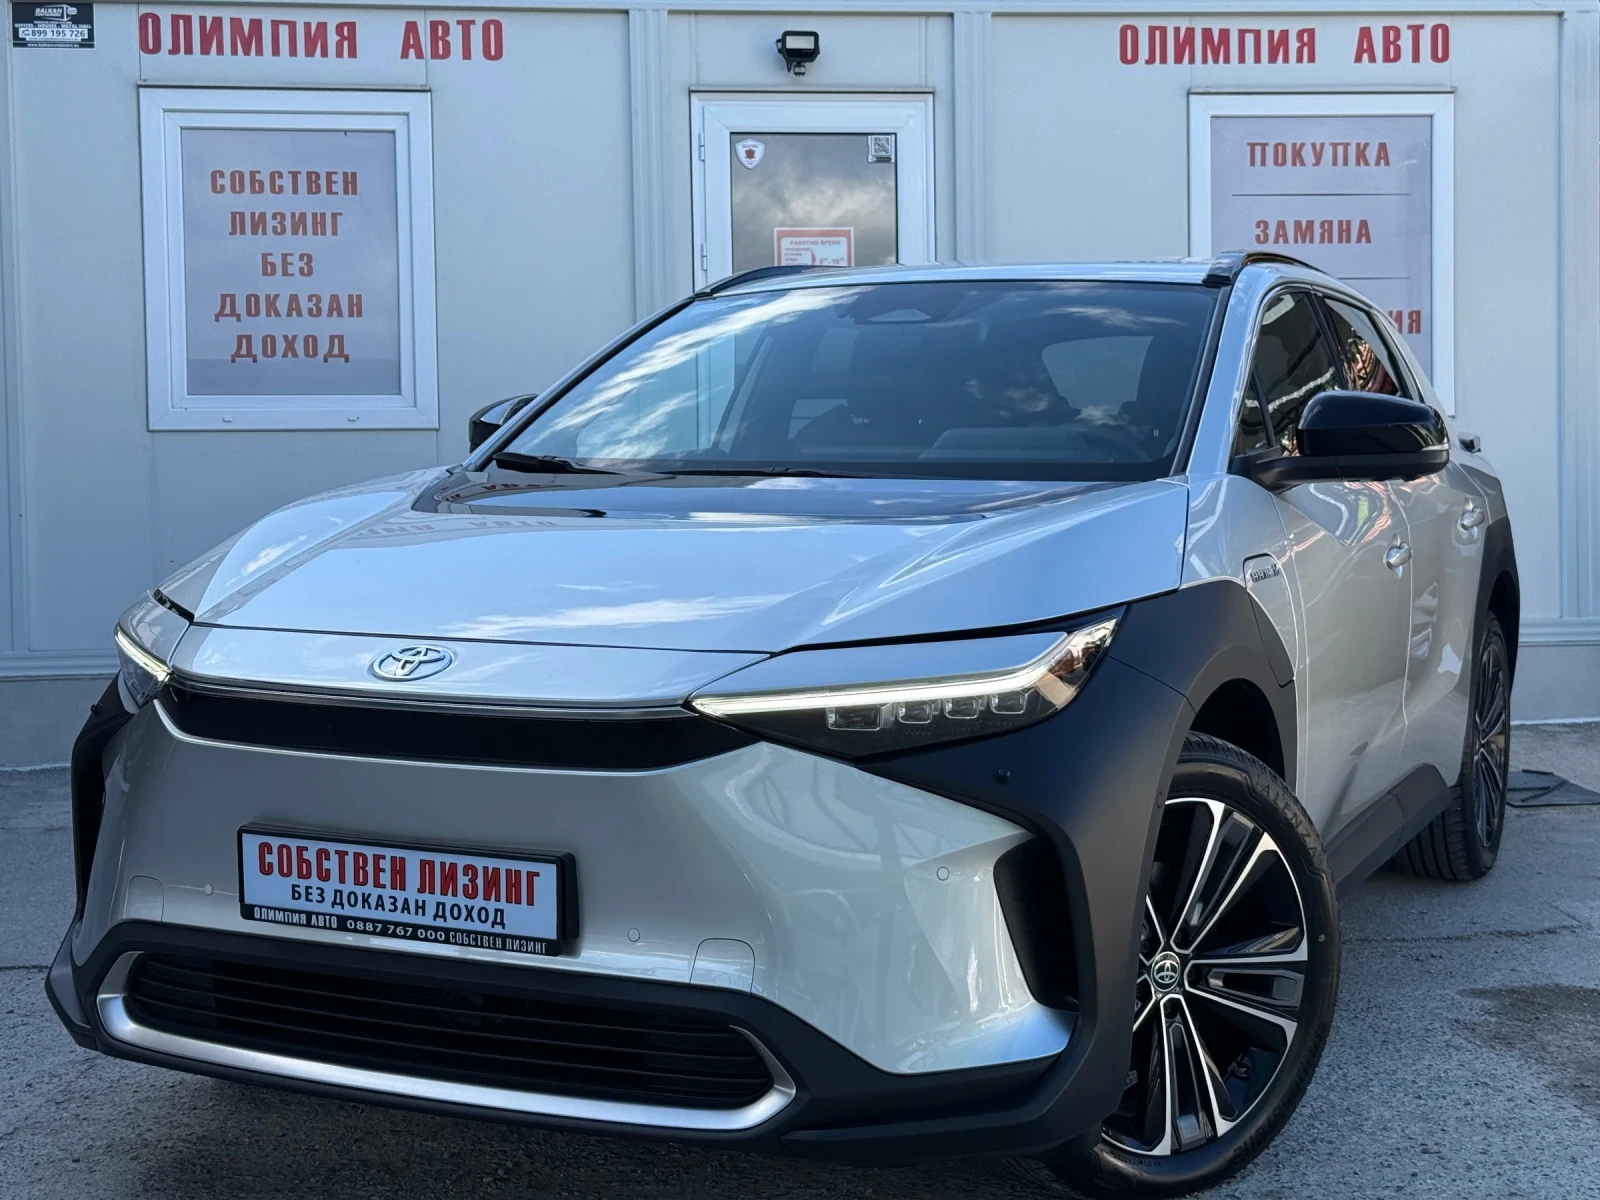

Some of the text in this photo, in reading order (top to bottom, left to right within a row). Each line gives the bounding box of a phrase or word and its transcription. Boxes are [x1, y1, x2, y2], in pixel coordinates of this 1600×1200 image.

[31, 29, 47, 38] 899
[50, 29, 67, 38] 195
[69, 29, 86, 38] 726
[139, 12, 504, 61] ОЛИМПИЯ АВТО
[1119, 23, 1450, 65] ОЛИМПИЯ АВТО
[1247, 141, 1391, 167] ПОКУПКА
[210, 169, 358, 196] СОБСТВЕН
[228, 211, 344, 237] ЛИЗИНГ
[1255, 219, 1372, 244] ЗАМЯНА
[260, 252, 314, 278] БЕЗ
[214, 292, 364, 323] ДОКАЗАН
[230, 333, 350, 364] ДОХОД
[258, 841, 540, 907] СОБСТВЕН ЛИЗИНГ
[291, 883, 506, 930] БЕЗ ДОКАЗАН ДОХОД
[253, 906, 547, 955] ОЛИМПИЯ АВТО 0887 767 000 СОБСТВЕН ЛИЗИНГ
